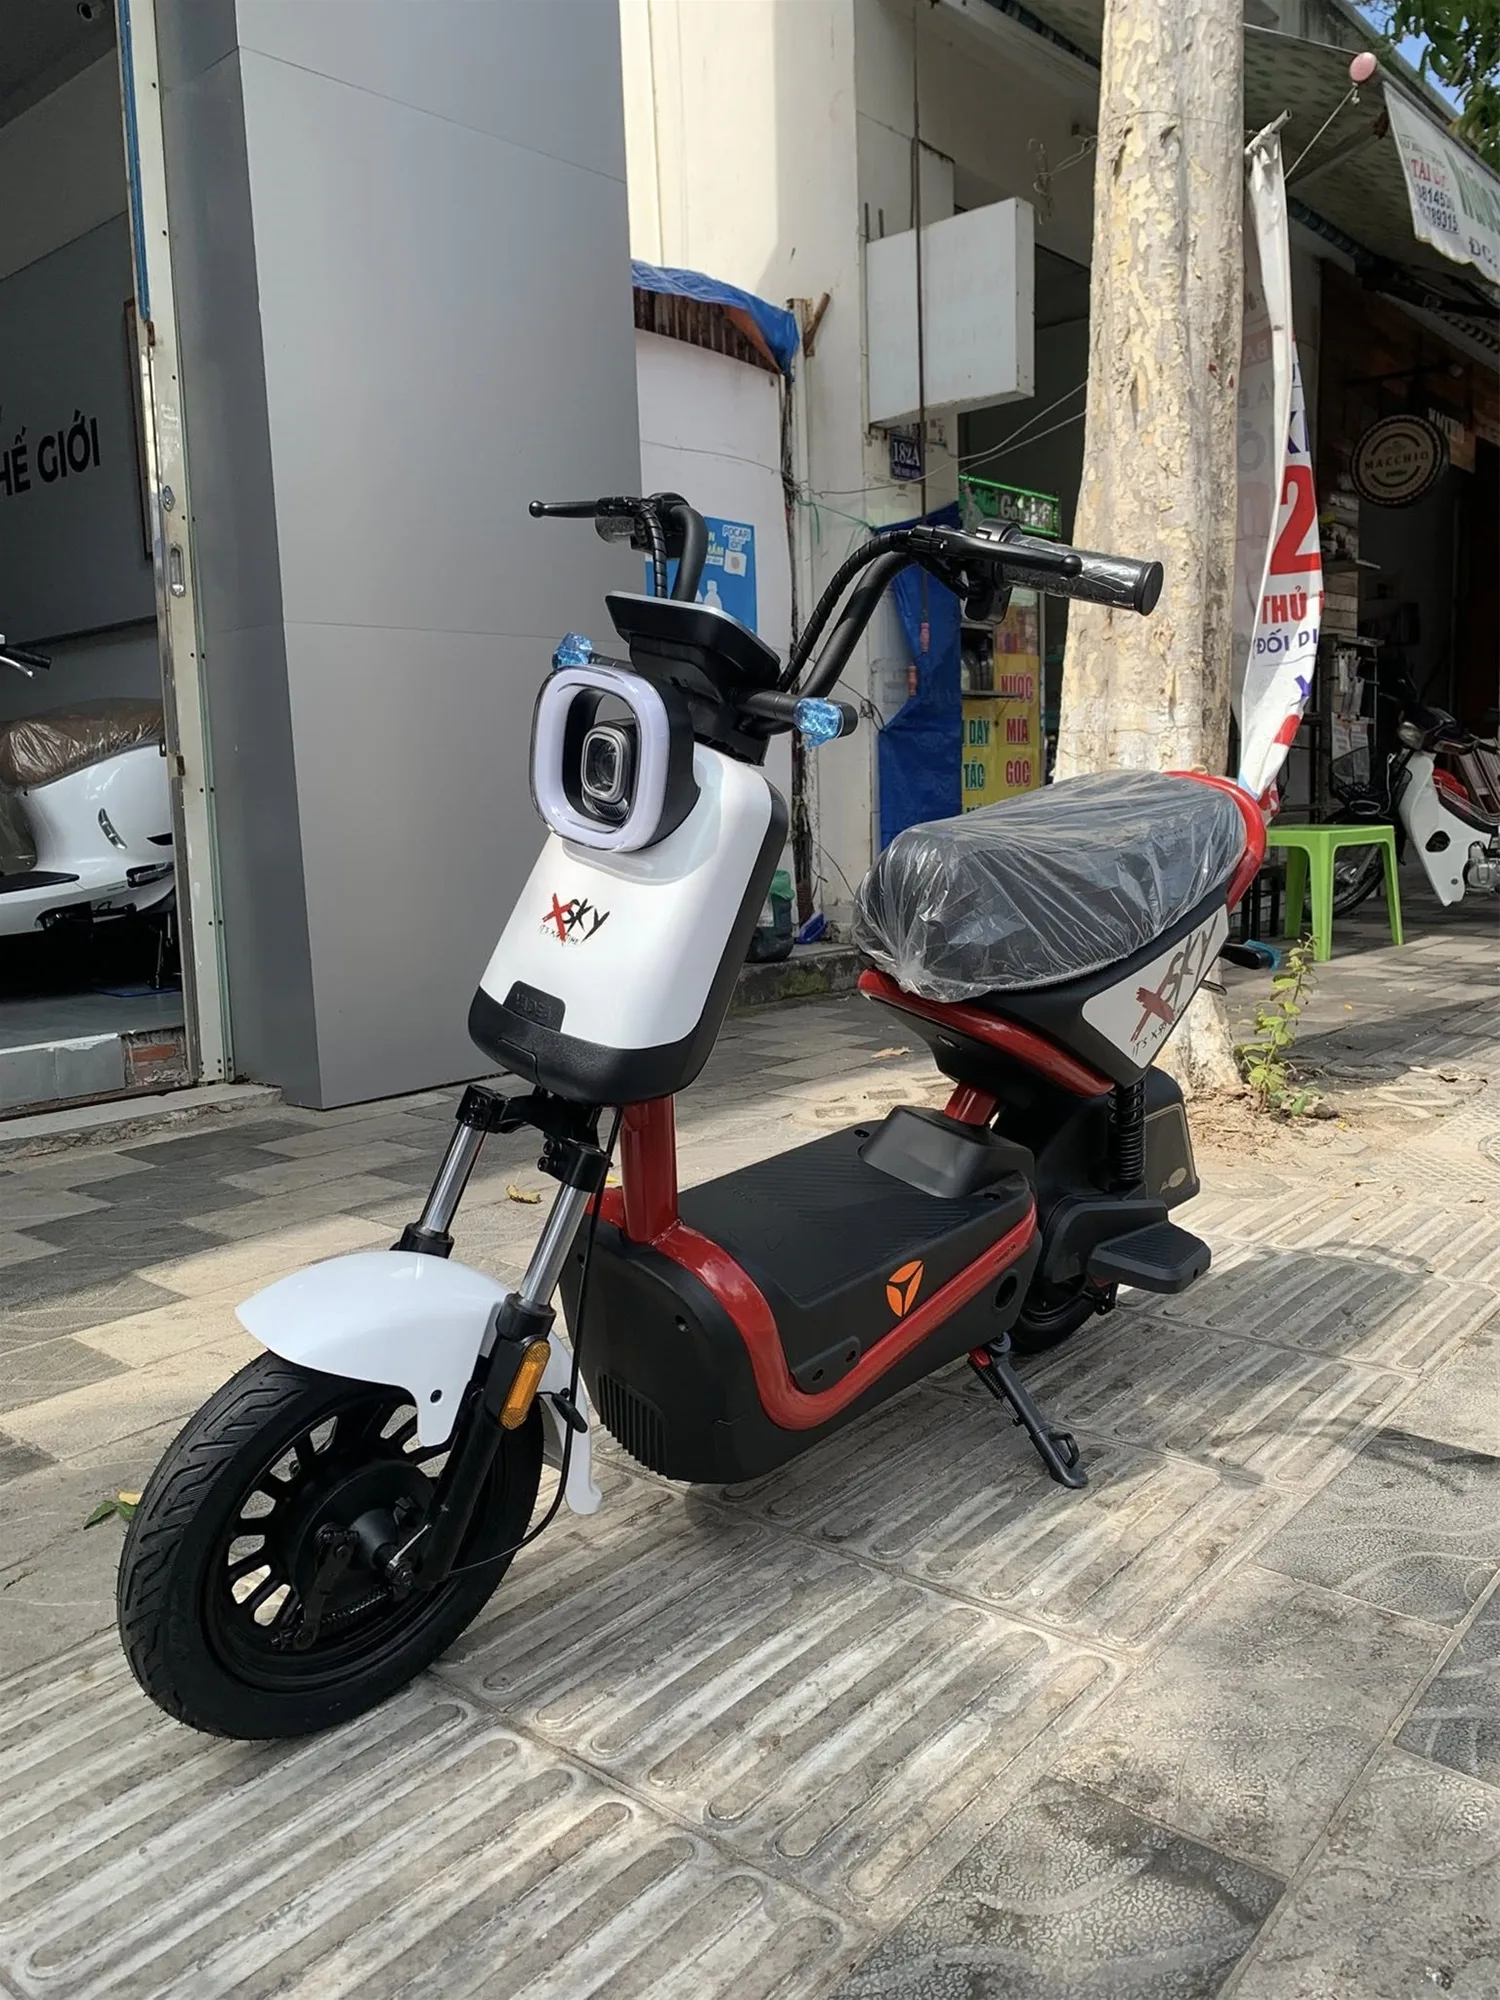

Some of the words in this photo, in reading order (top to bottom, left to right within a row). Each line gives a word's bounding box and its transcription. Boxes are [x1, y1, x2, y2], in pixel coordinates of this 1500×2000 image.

[37, 409, 100, 483] GIỚI
[1364, 451, 1429, 470] MACCHIO
[1262, 585, 1307, 624] THỦ
